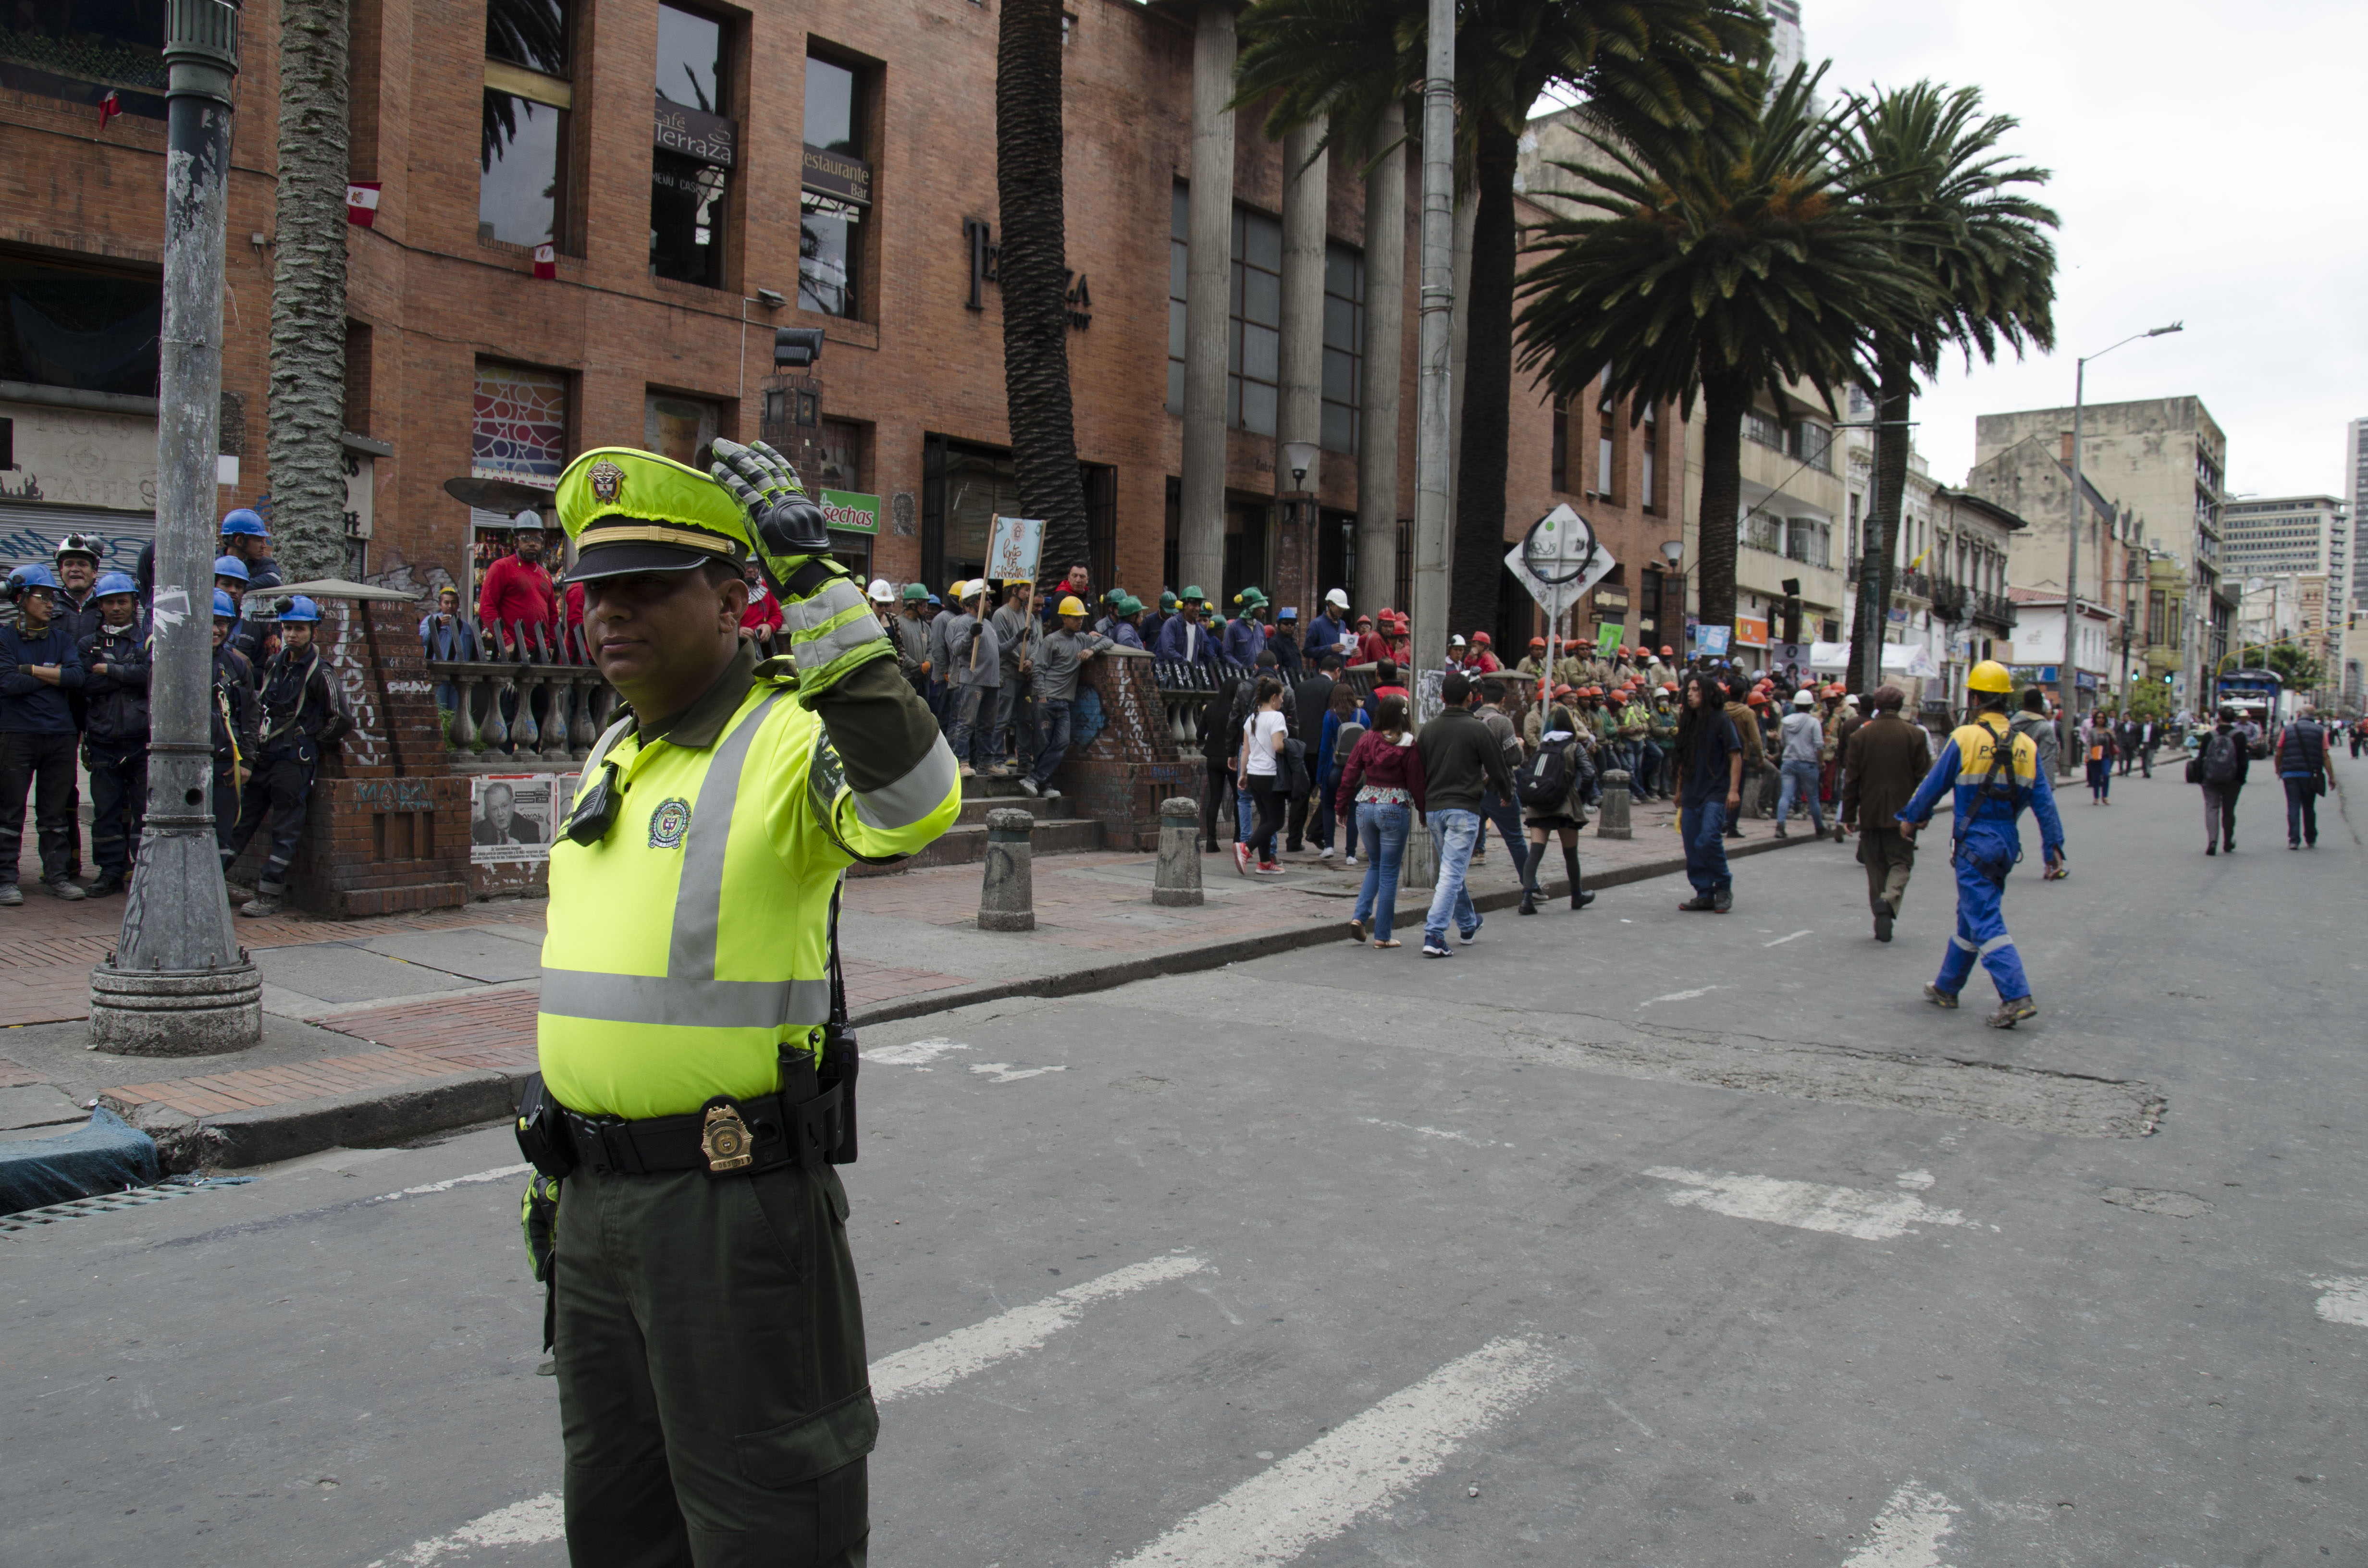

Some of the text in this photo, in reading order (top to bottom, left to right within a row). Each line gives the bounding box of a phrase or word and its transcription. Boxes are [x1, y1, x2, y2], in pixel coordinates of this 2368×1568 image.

[654, 122, 731, 164] Terraza
[803, 152, 869, 184] estaurante
[851, 183, 867, 198] Bar
[823, 505, 874, 527] sechas
